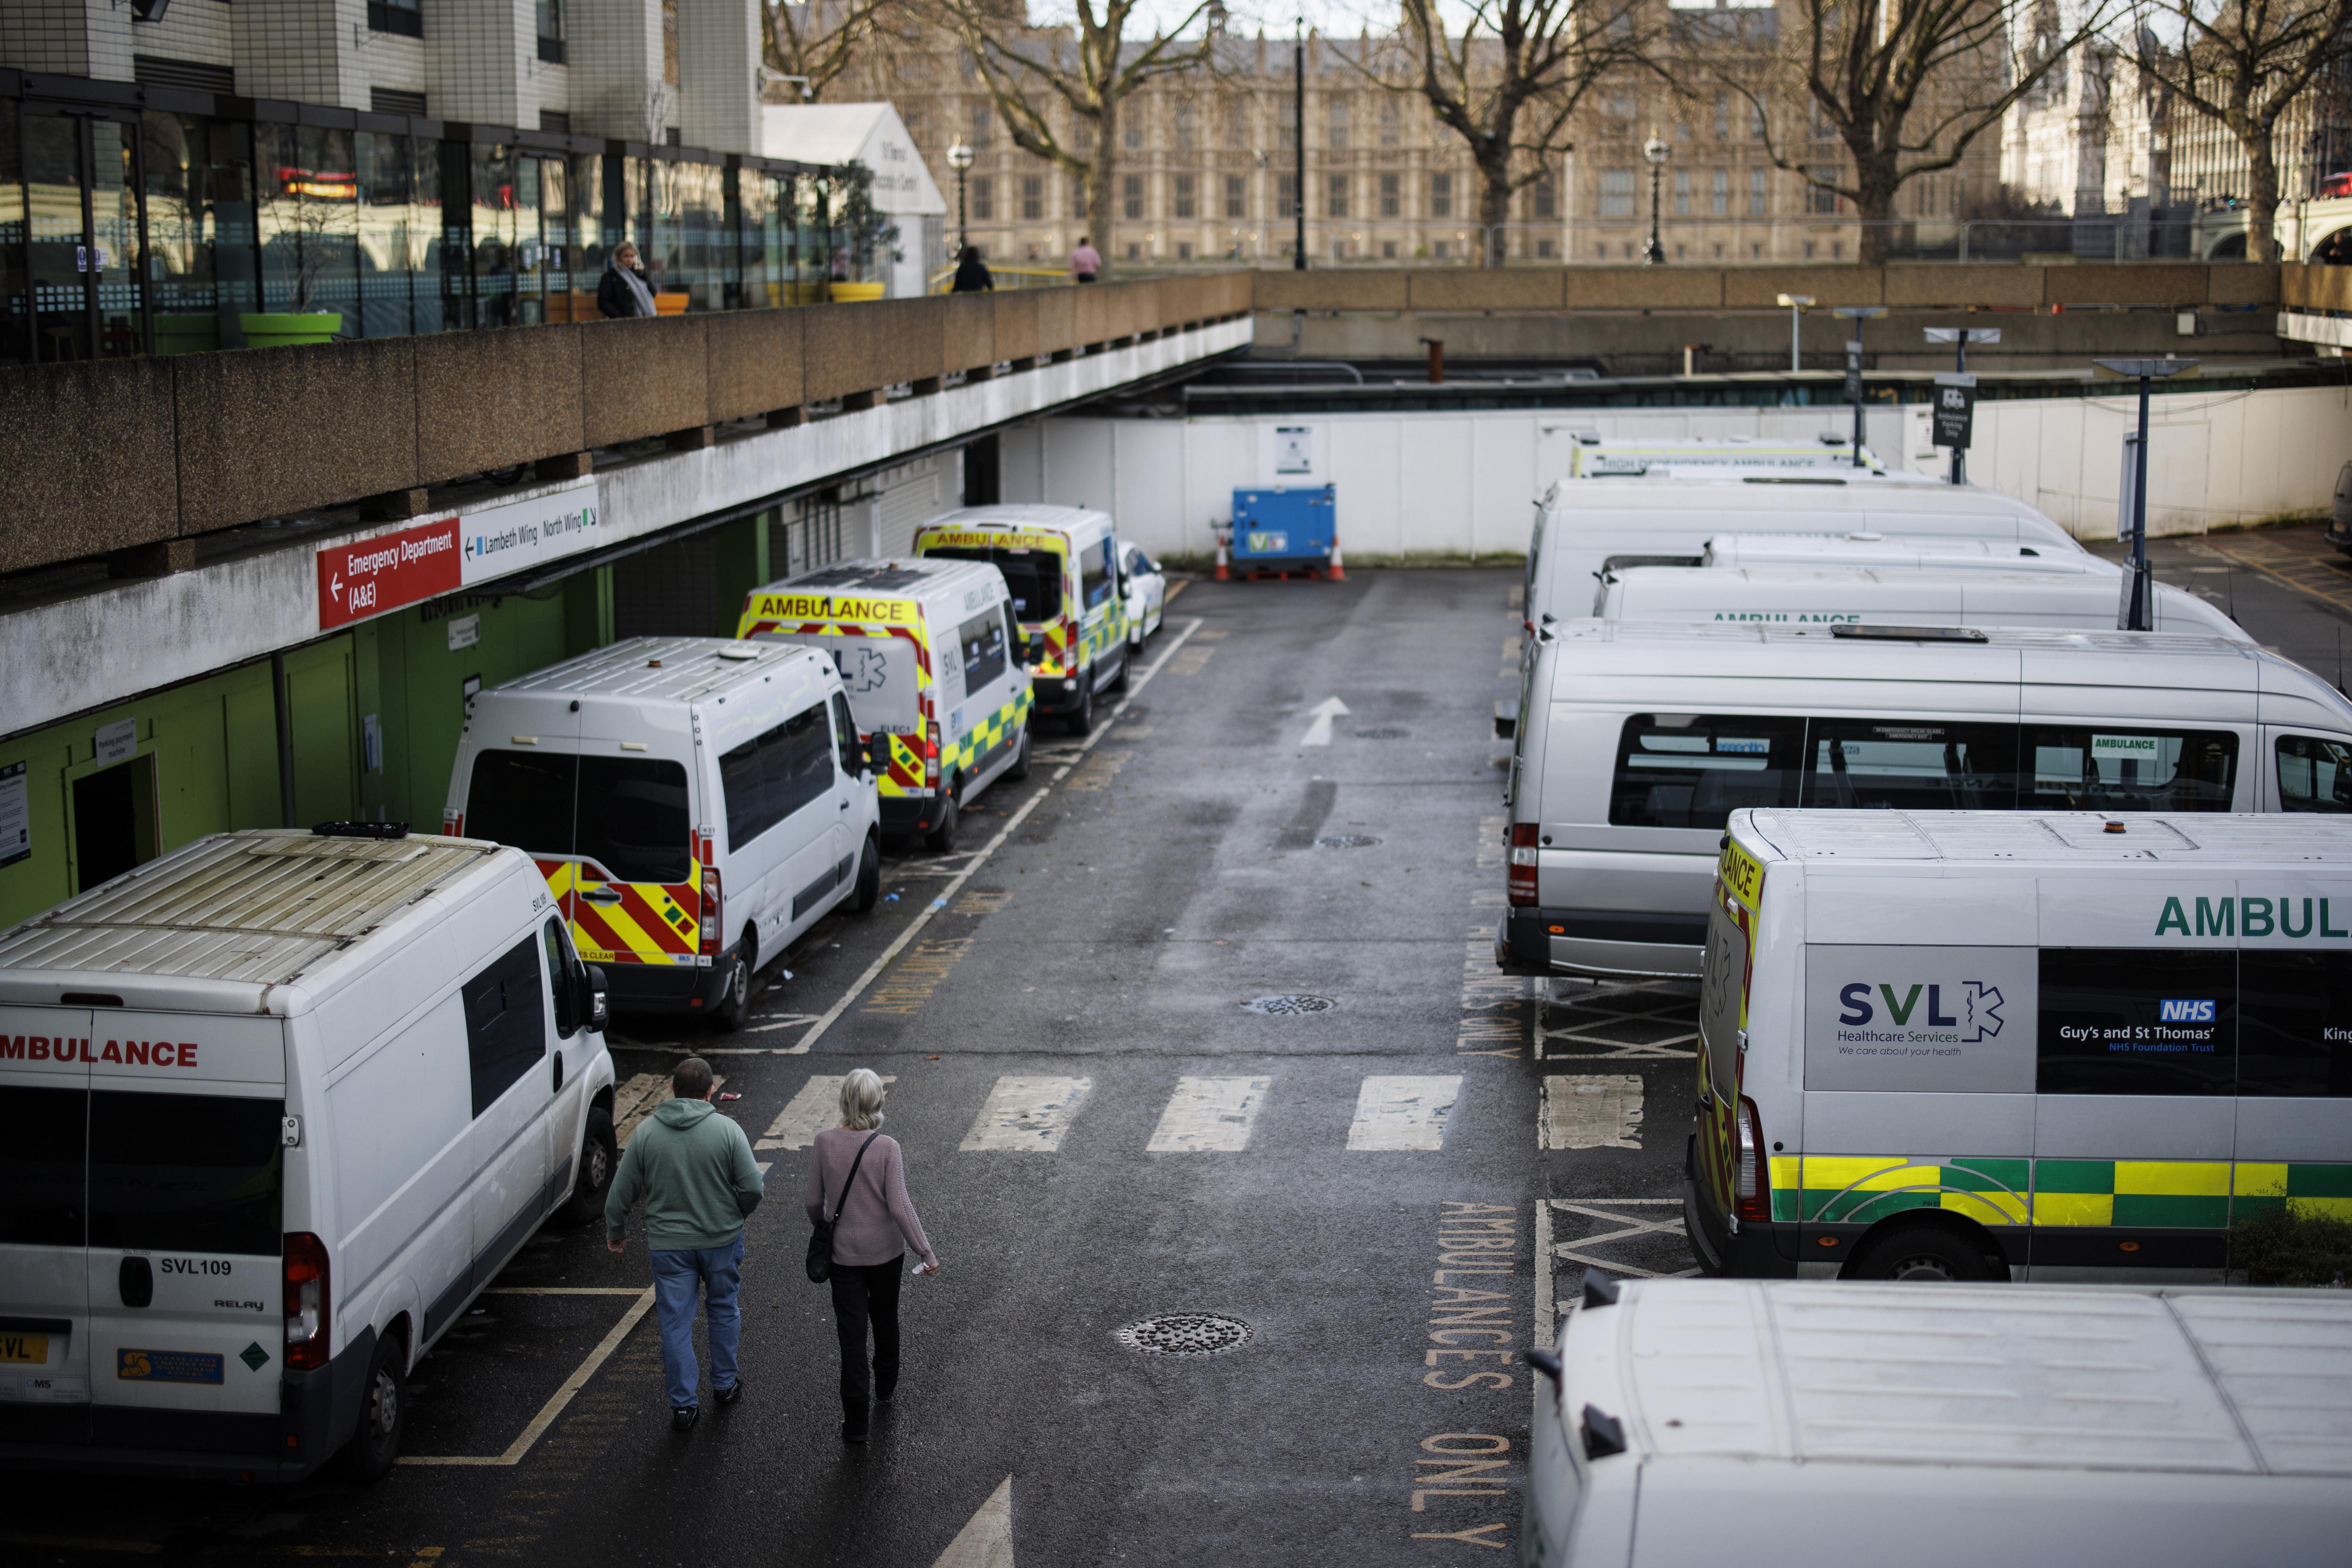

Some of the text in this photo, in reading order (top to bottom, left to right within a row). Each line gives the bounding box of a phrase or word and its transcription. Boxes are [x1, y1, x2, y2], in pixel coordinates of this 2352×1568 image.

[1602, 459, 1635, 469] HIGH
[543, 513, 582, 538] North Wing
[485, 524, 537, 554] Lambeth Wing
[938, 534, 1046, 548] AMBULANCE
[348, 531, 453, 577] Emergency Department
[349, 581, 376, 614] (A&E)
[761, 598, 903, 620] AMBULANCE
[99, 732, 134, 748] Parking payment
[2095, 739, 2155, 750] AMBULANCE
[109, 746, 126, 758] machine
[1839, 982, 1956, 1026] SVL
[2162, 1002, 2214, 1020] NHS
[1456, 1016, 1522, 1059] ONLY
[1838, 1030, 1958, 1043] Healthcare Services
[2060, 1026, 2215, 1041] Guy's and St Thomas'
[1839, 1046, 1854, 1055] We
[1880, 1046, 1907, 1055] about
[1910, 1049, 1931, 1057] your
[1932, 1046, 1961, 1056] health
[2133, 1043, 2187, 1052] Foundation
[2191, 1044, 2215, 1052] Trust
[162, 1259, 231, 1275] SVL109
[1410, 1201, 1517, 1549] AMBULANCES ONLY
[26, 1378, 51, 1389] QMS
